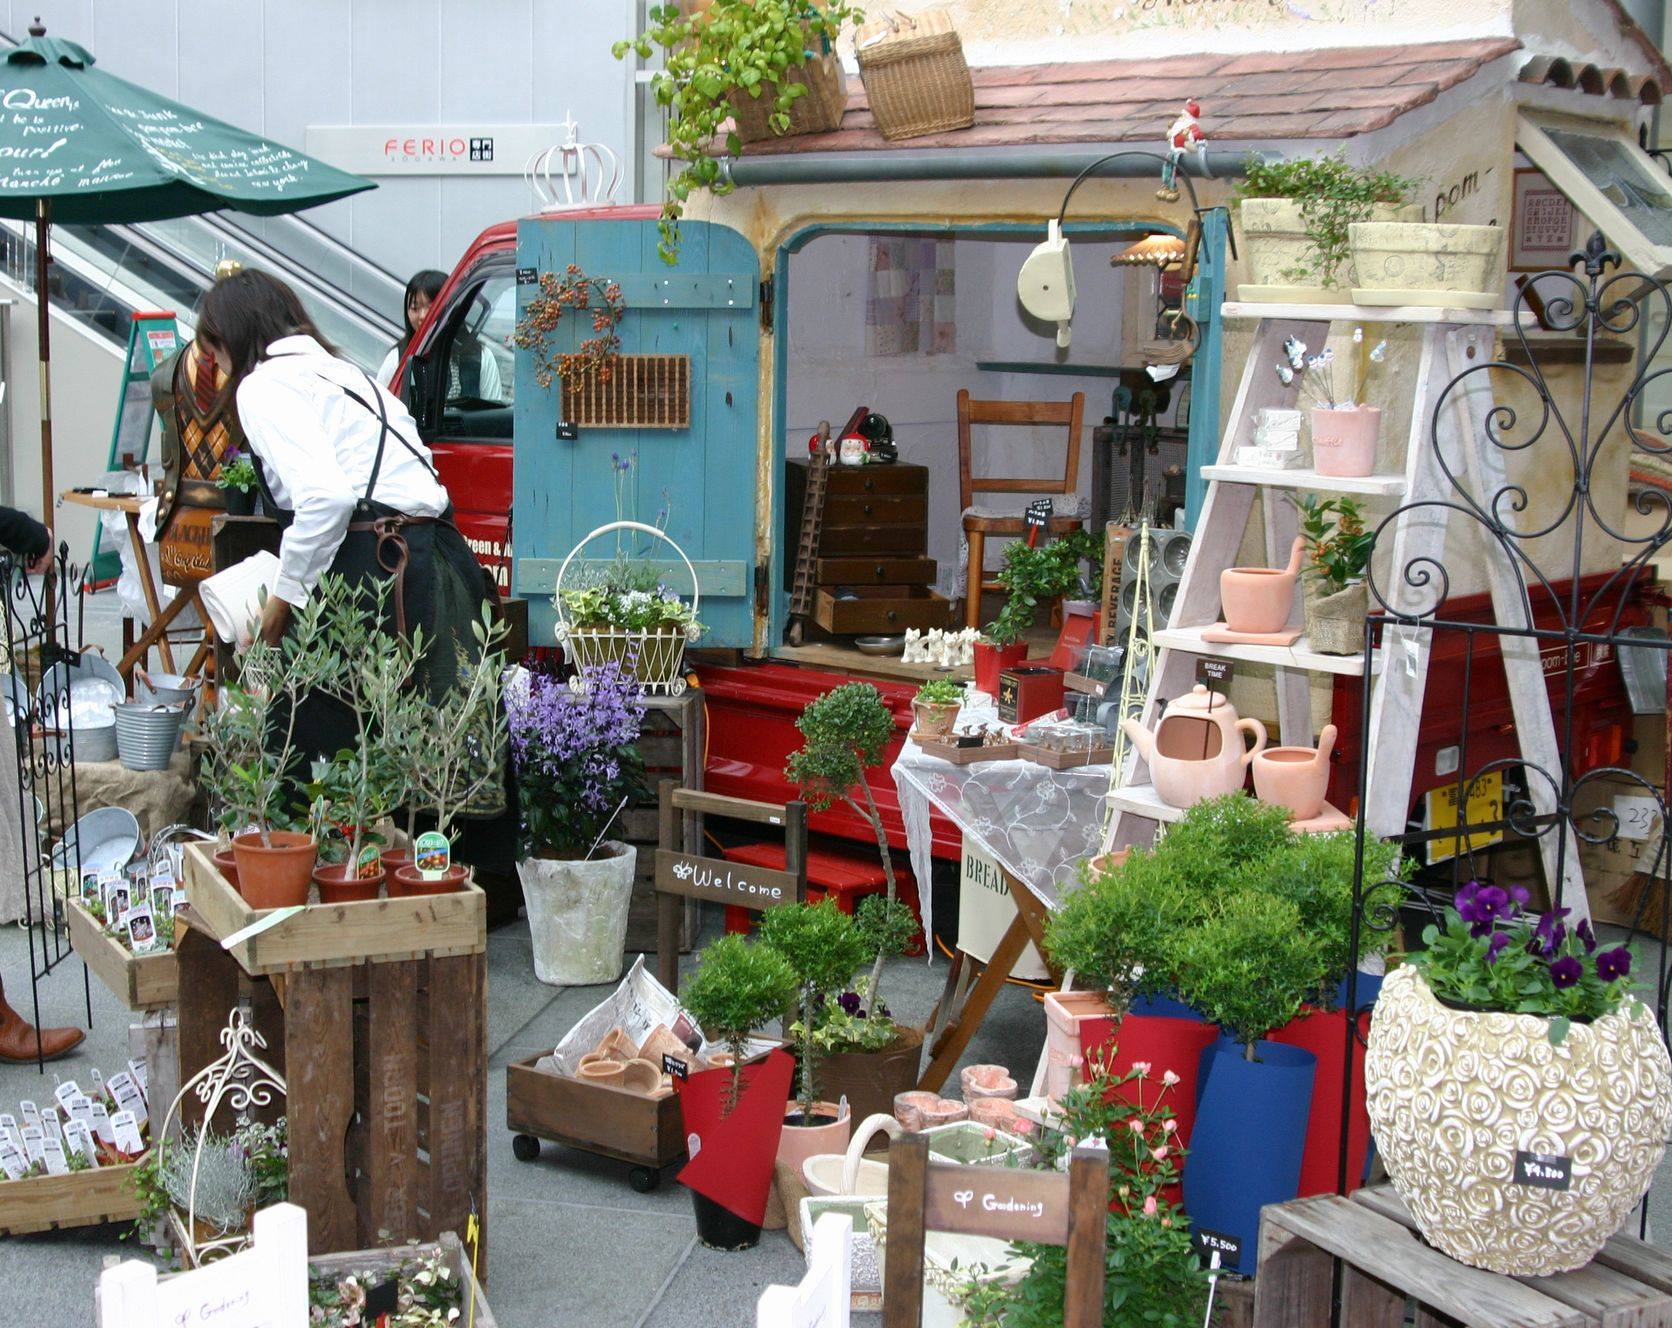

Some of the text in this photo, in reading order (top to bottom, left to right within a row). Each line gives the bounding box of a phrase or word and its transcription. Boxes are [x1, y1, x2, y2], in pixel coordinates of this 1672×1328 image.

[385, 138, 466, 155] FERIO
[1107, 558, 1122, 629] BEVERAGE
[1204, 662, 1227, 671] BREAK
[1207, 670, 1223, 678] TIME
[693, 864, 782, 899] Welcome
[966, 854, 1010, 896] BREAD
